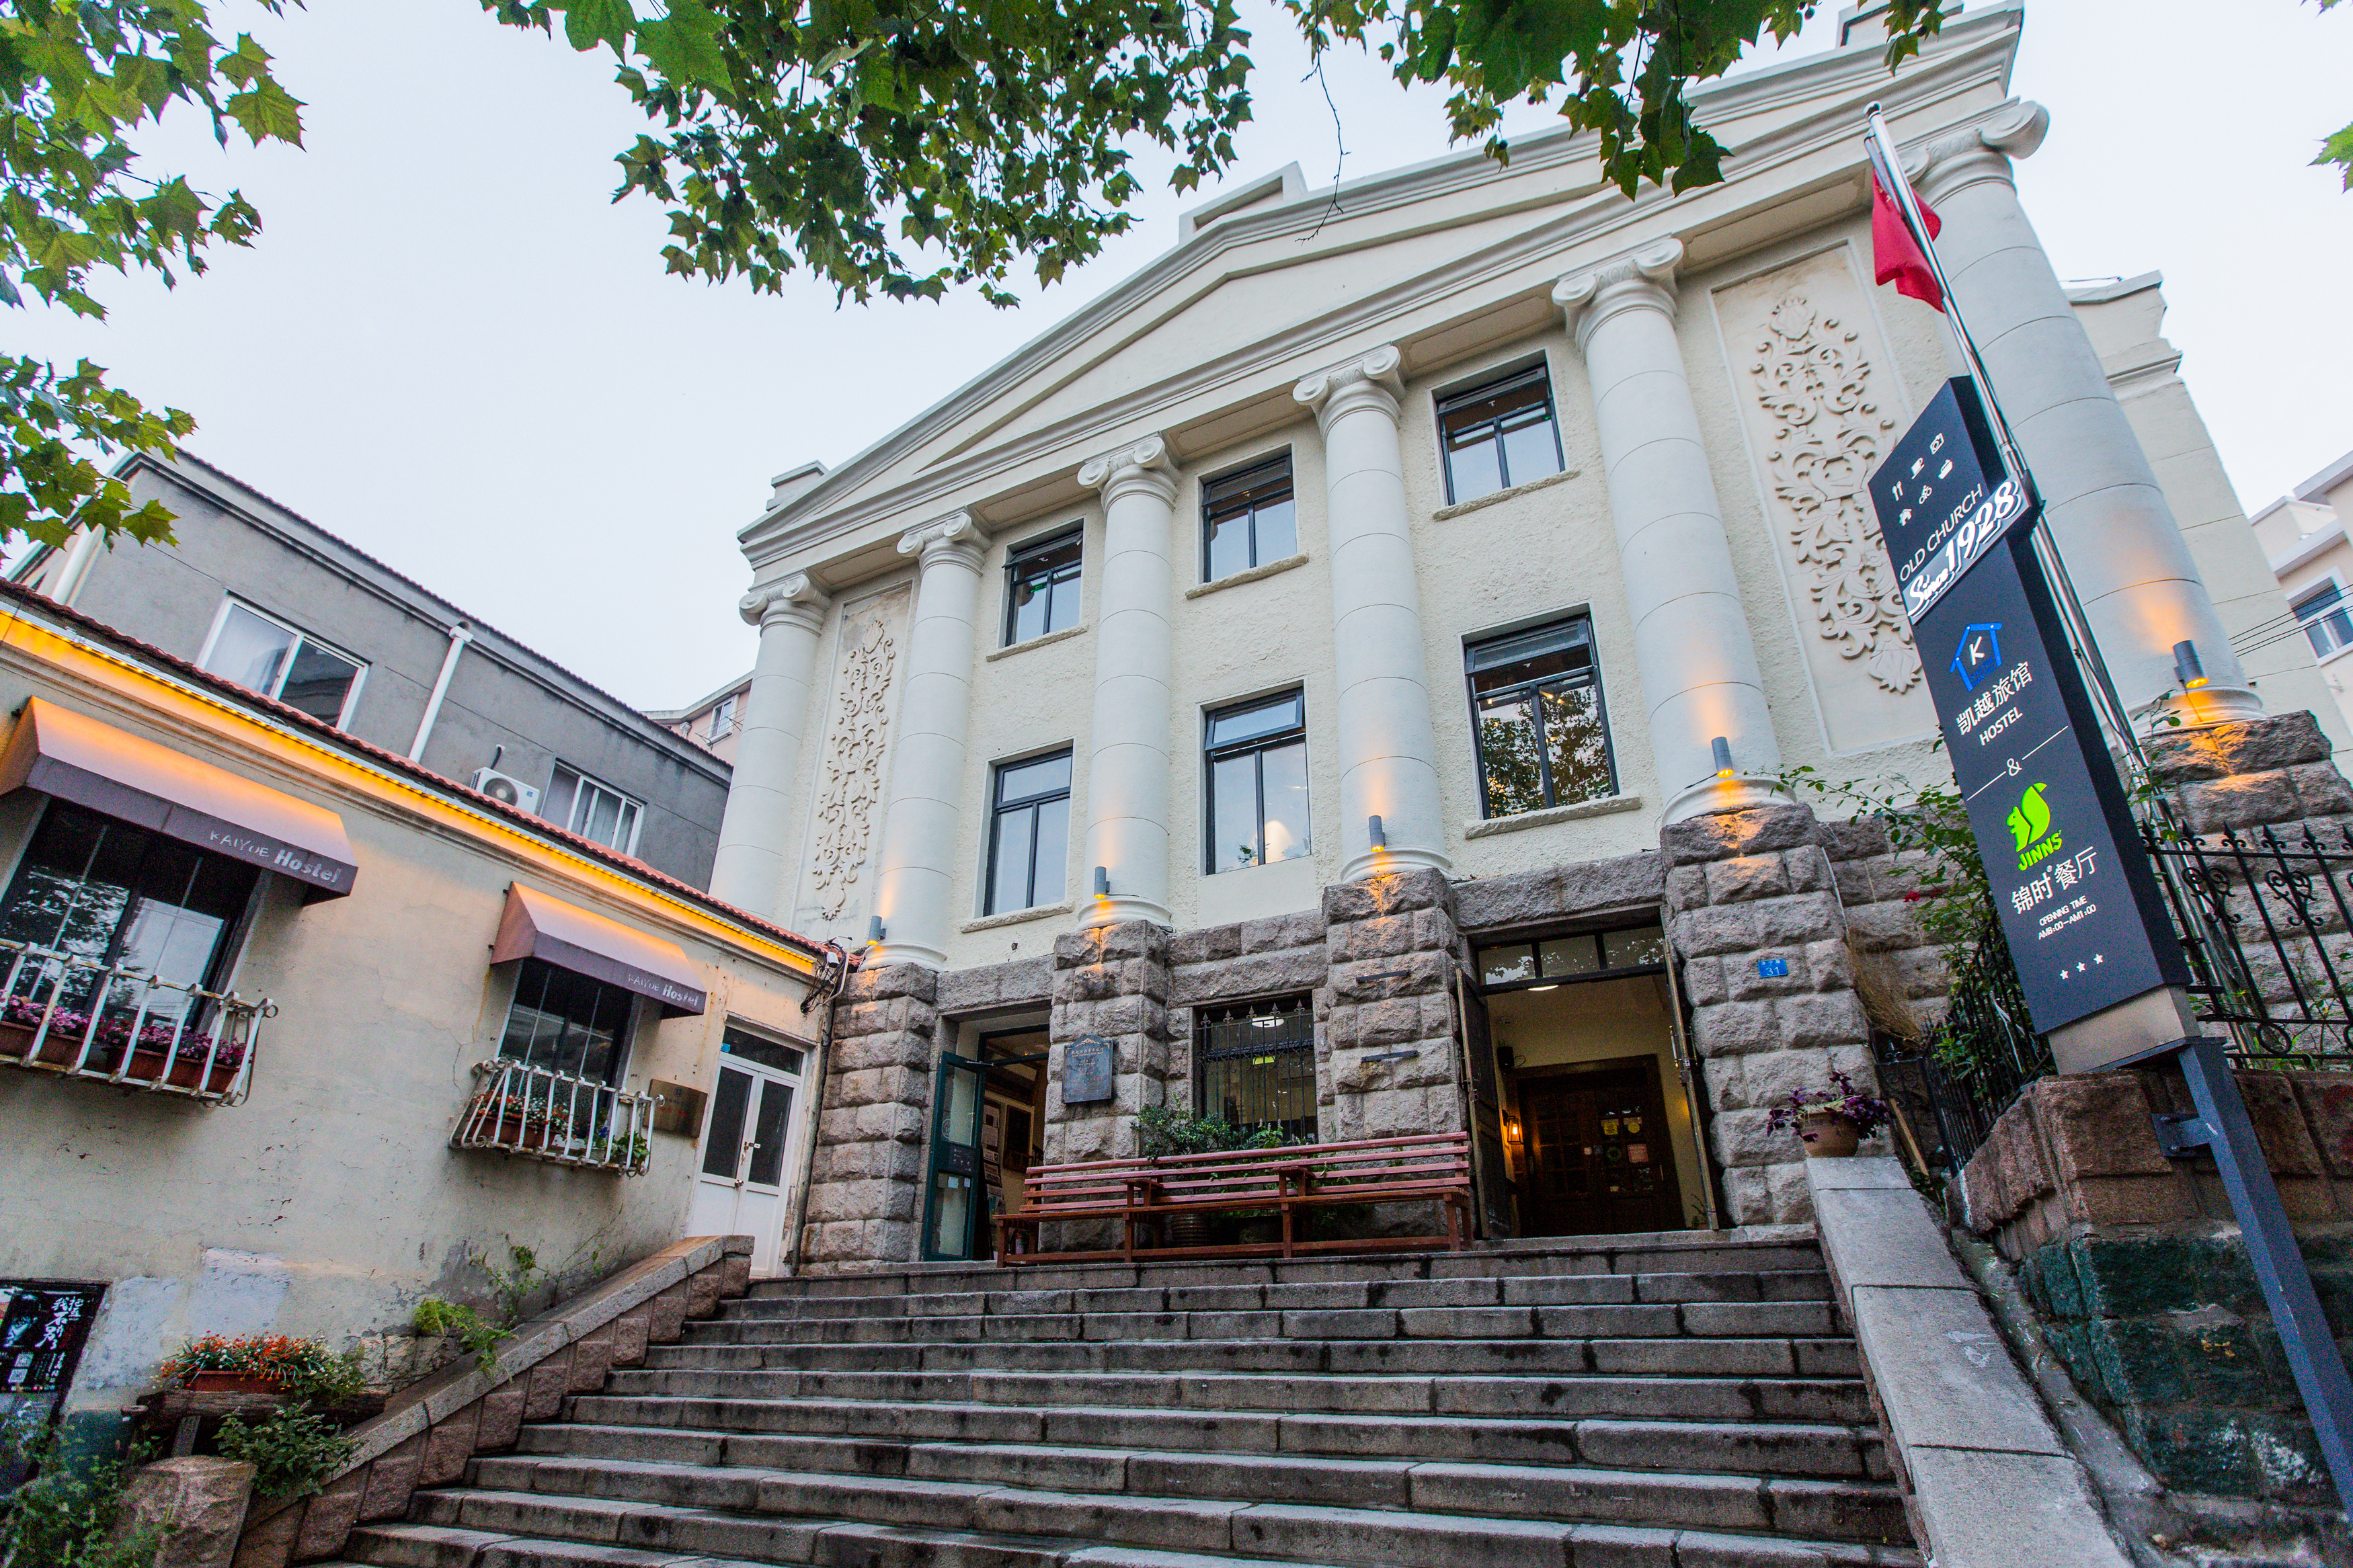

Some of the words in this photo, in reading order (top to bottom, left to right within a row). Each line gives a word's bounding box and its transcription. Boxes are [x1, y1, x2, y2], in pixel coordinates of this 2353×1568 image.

[1900, 548, 1925, 581] OLD
[1927, 483, 1983, 552] CHURCH
[1907, 567, 1954, 617] Since
[1945, 480, 2022, 573] 1928
[1968, 636, 1985, 665] K
[1972, 664, 1997, 688] HOSTEL
[1955, 661, 2033, 735] 凯越旅馆
[1979, 706, 2024, 746] HOSTEL
[2006, 757, 2023, 777] &
[210, 830, 269, 857] KAIYUE
[274, 849, 342, 883] Hostel
[2018, 832, 2063, 871] JINNS
[2069, 895, 2088, 909] TIME
[1765, 966, 1780, 976] 31
[628, 974, 660, 991] KAIYUE
[662, 984, 699, 1006] Hostel
